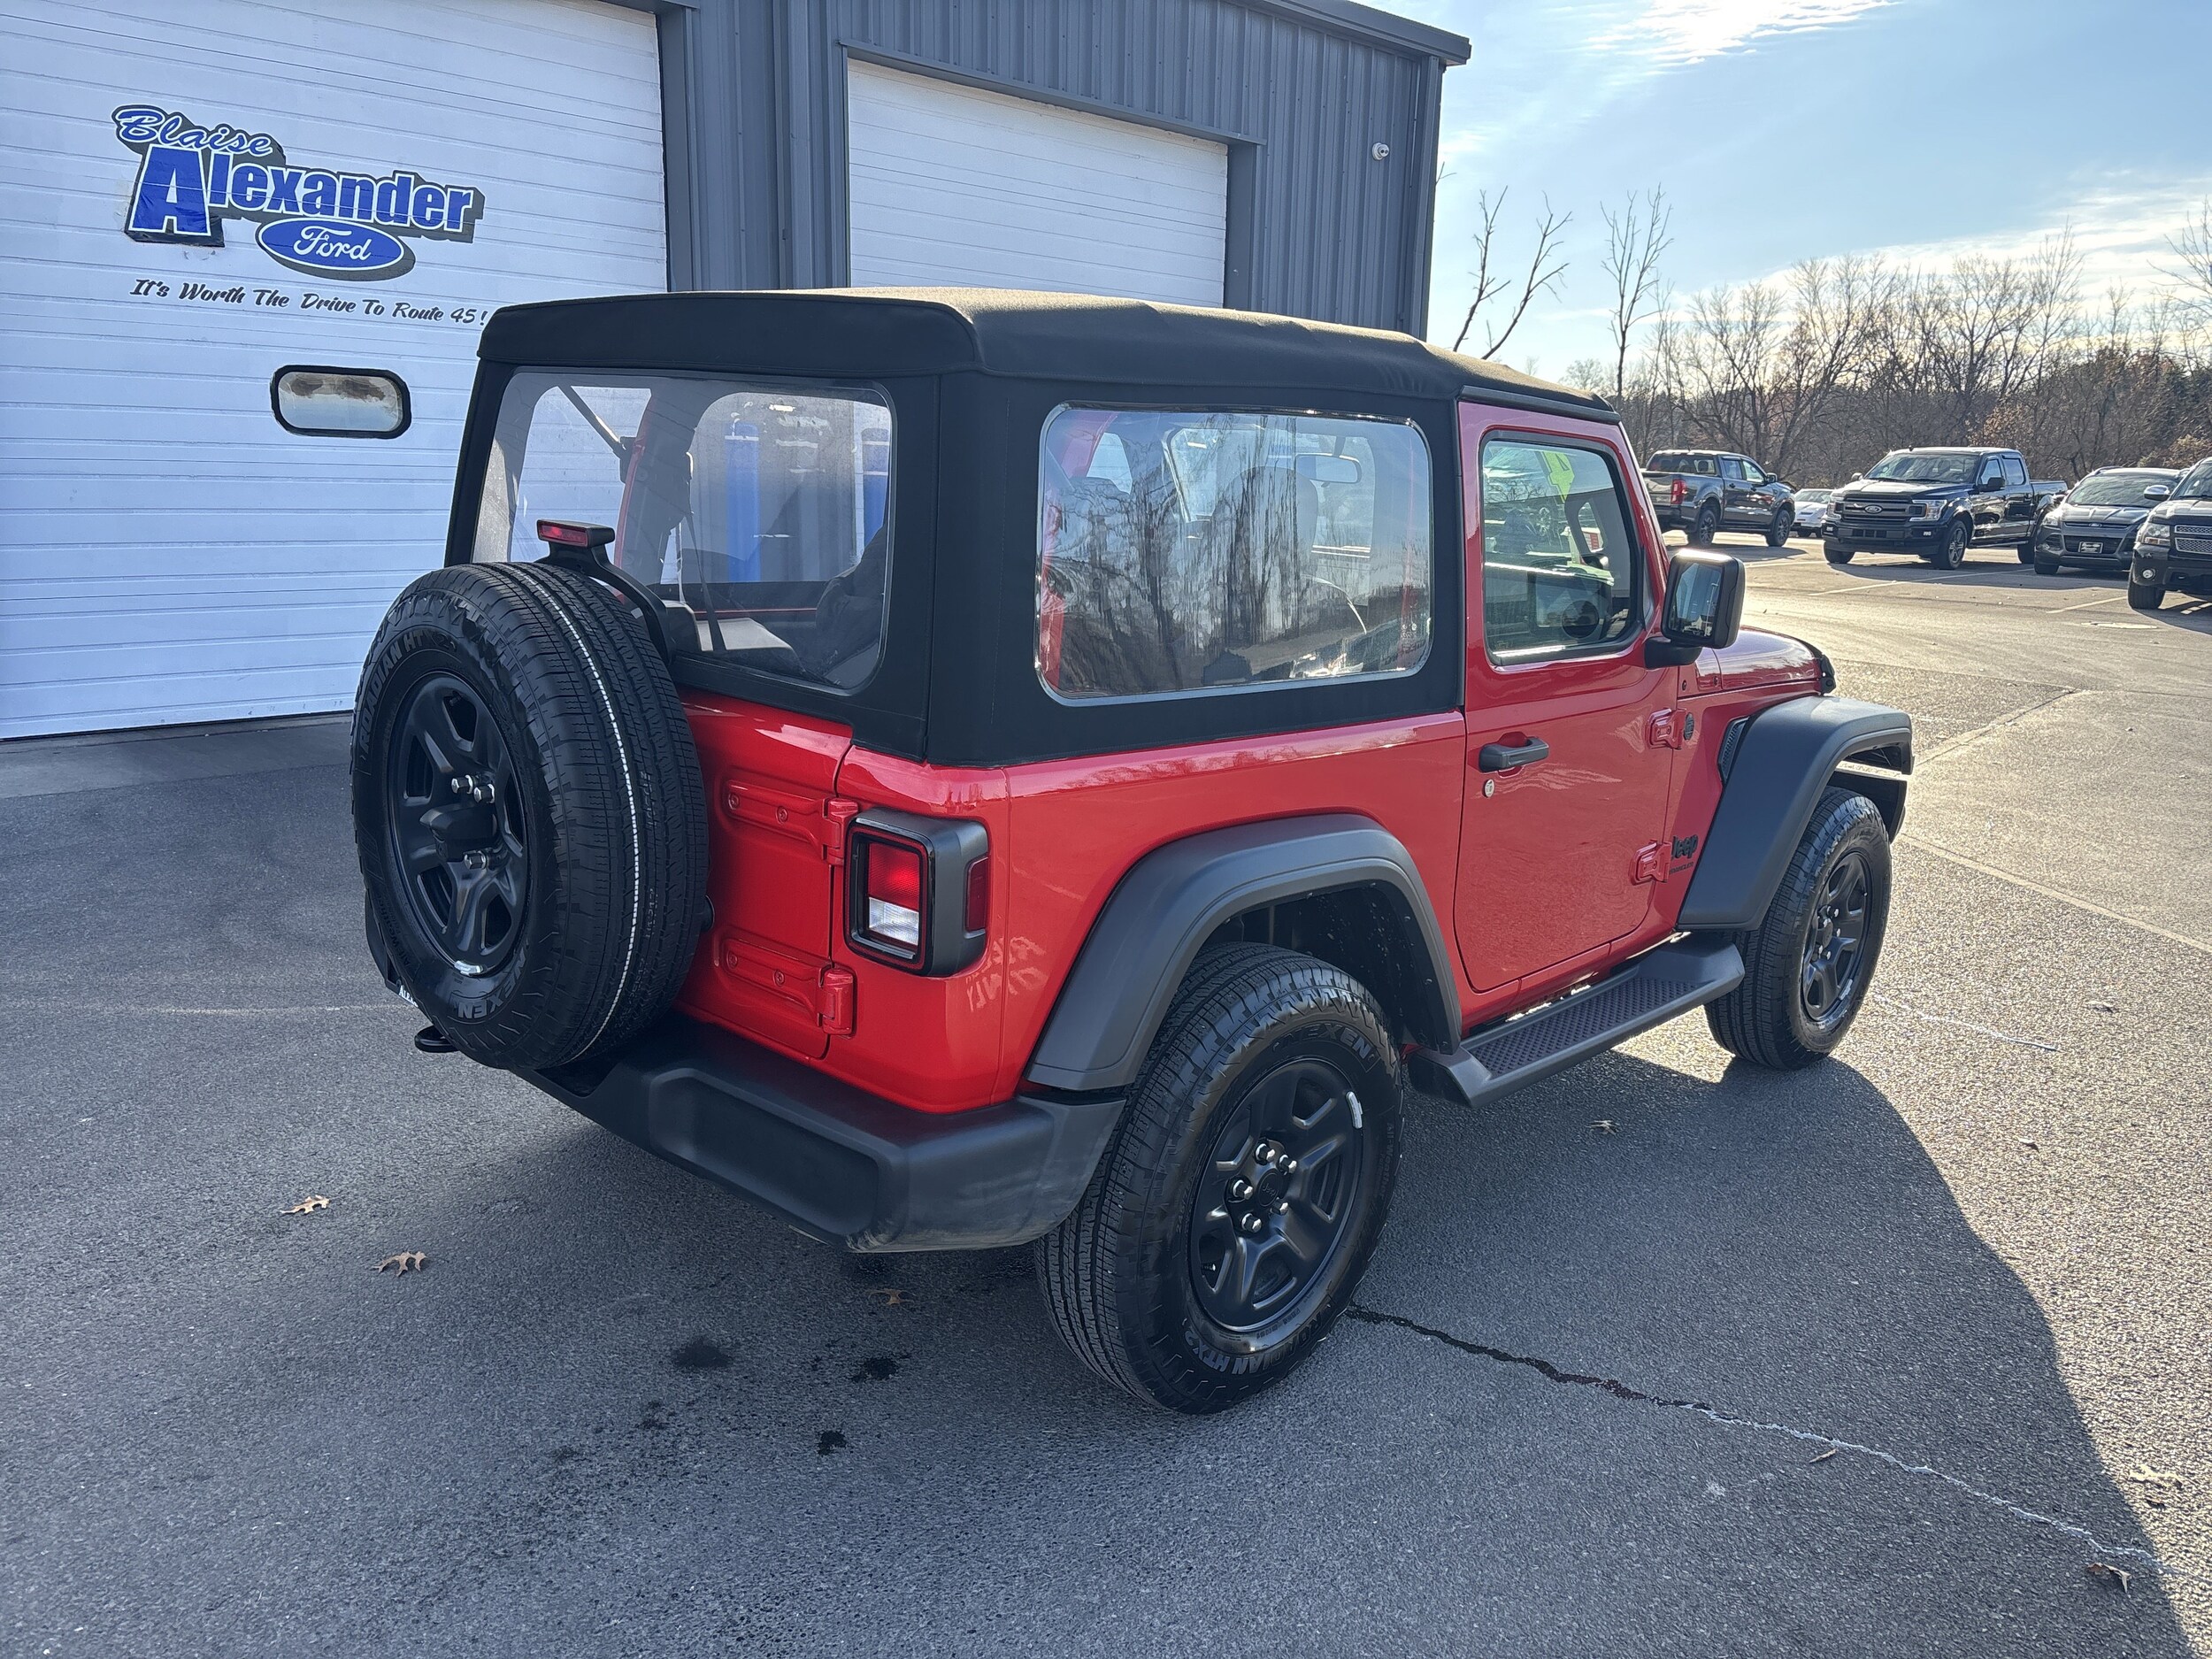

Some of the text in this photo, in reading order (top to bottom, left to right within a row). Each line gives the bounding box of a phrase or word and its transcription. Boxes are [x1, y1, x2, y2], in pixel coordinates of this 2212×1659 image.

[116, 108, 273, 157] Blaise
[129, 143, 473, 236] Alexander
[294, 226, 373, 262] Ford
[130, 279, 170, 298] It's
[179, 282, 246, 304] Worth
[252, 288, 290, 308] The
[300, 293, 357, 313] Drive
[362, 299, 385, 316] To
[392, 302, 444, 322] Route
[358, 639, 403, 754] ROADIAN
[457, 947, 526, 1019] NEXEN
[1231, 1312, 1323, 1375] ROADIAN
